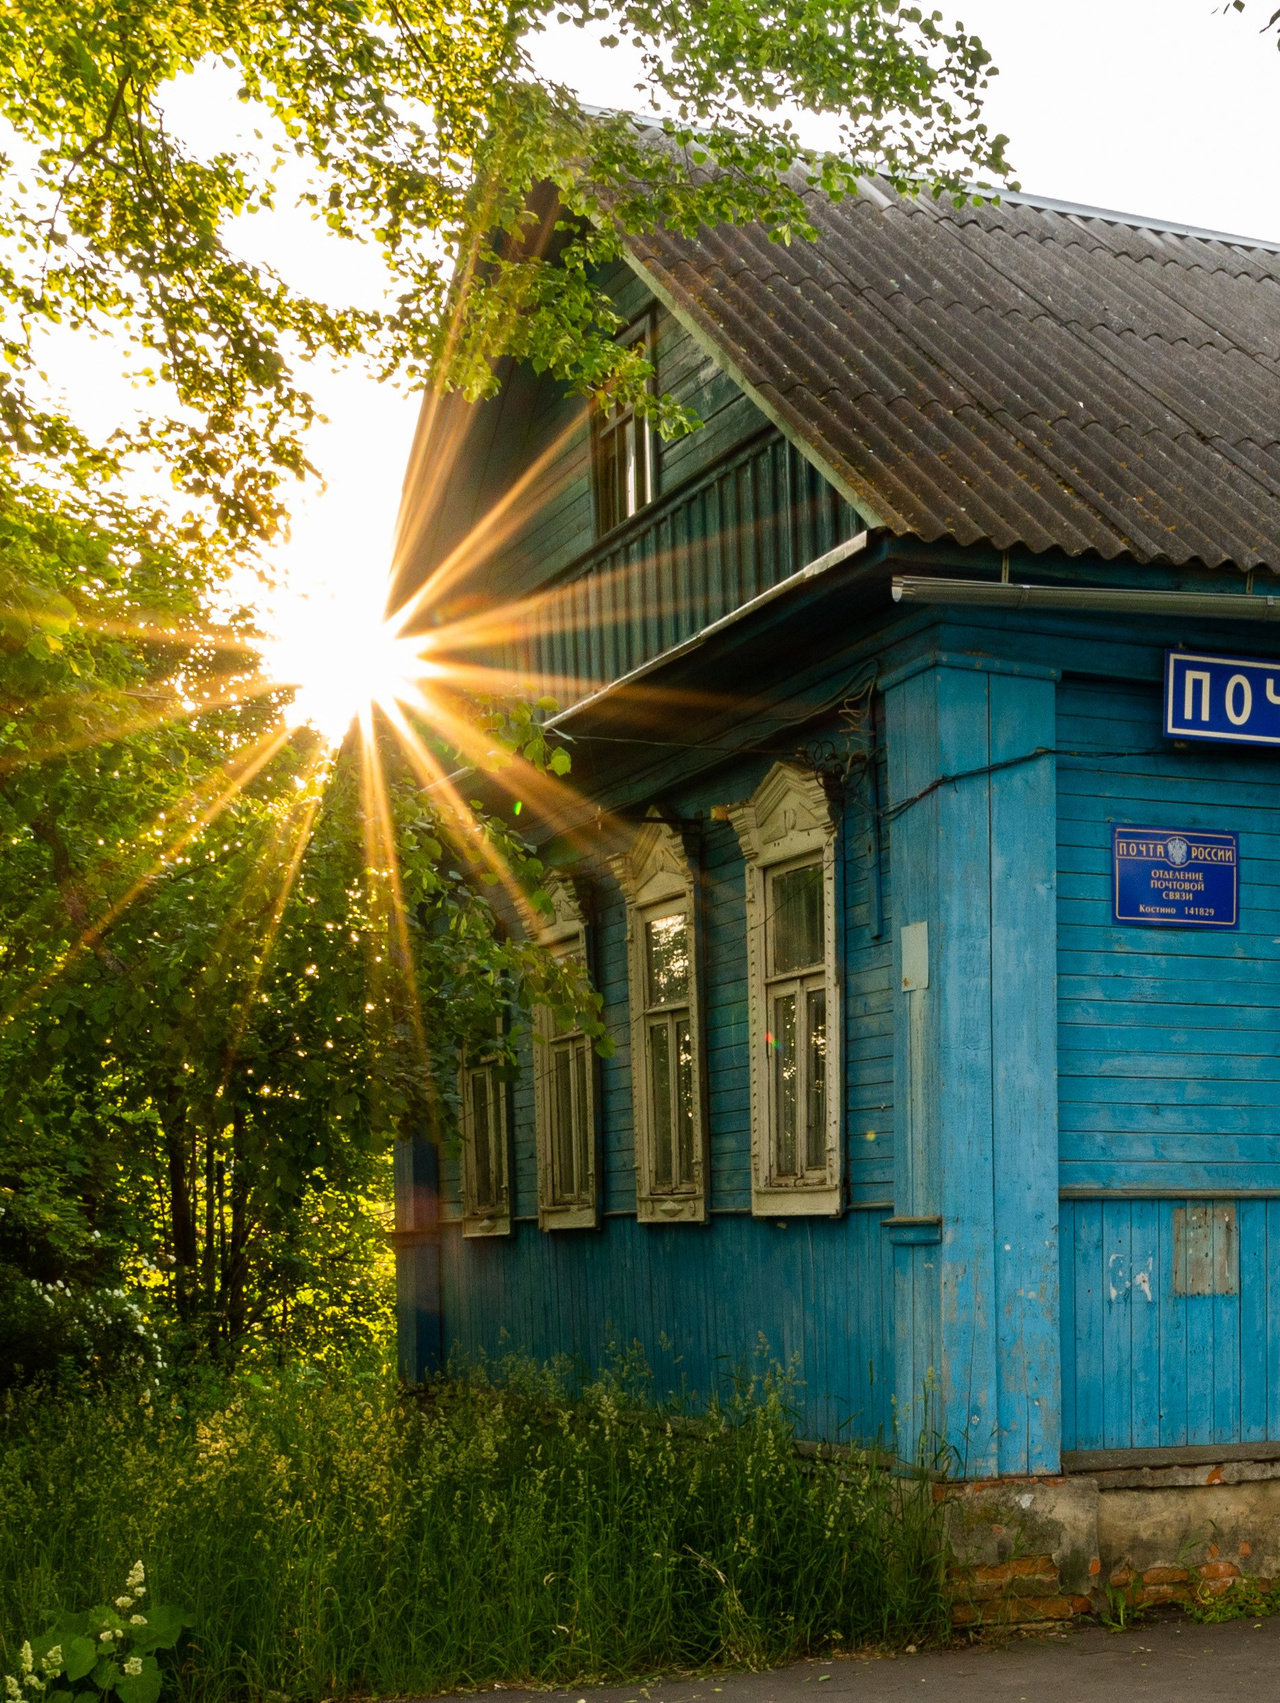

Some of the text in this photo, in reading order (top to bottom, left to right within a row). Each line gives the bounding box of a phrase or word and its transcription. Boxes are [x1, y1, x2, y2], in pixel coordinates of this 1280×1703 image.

[1118, 842, 1233, 862] ПОЧТА РОССИИ
[1150, 868, 1204, 882] ОТДЕЛЕНИЕ
[1150, 879, 1205, 892] ПОЧТОВОЙ
[1162, 890, 1193, 901] СВЯЗИ
[1138, 904, 1215, 917] Костино 141829
